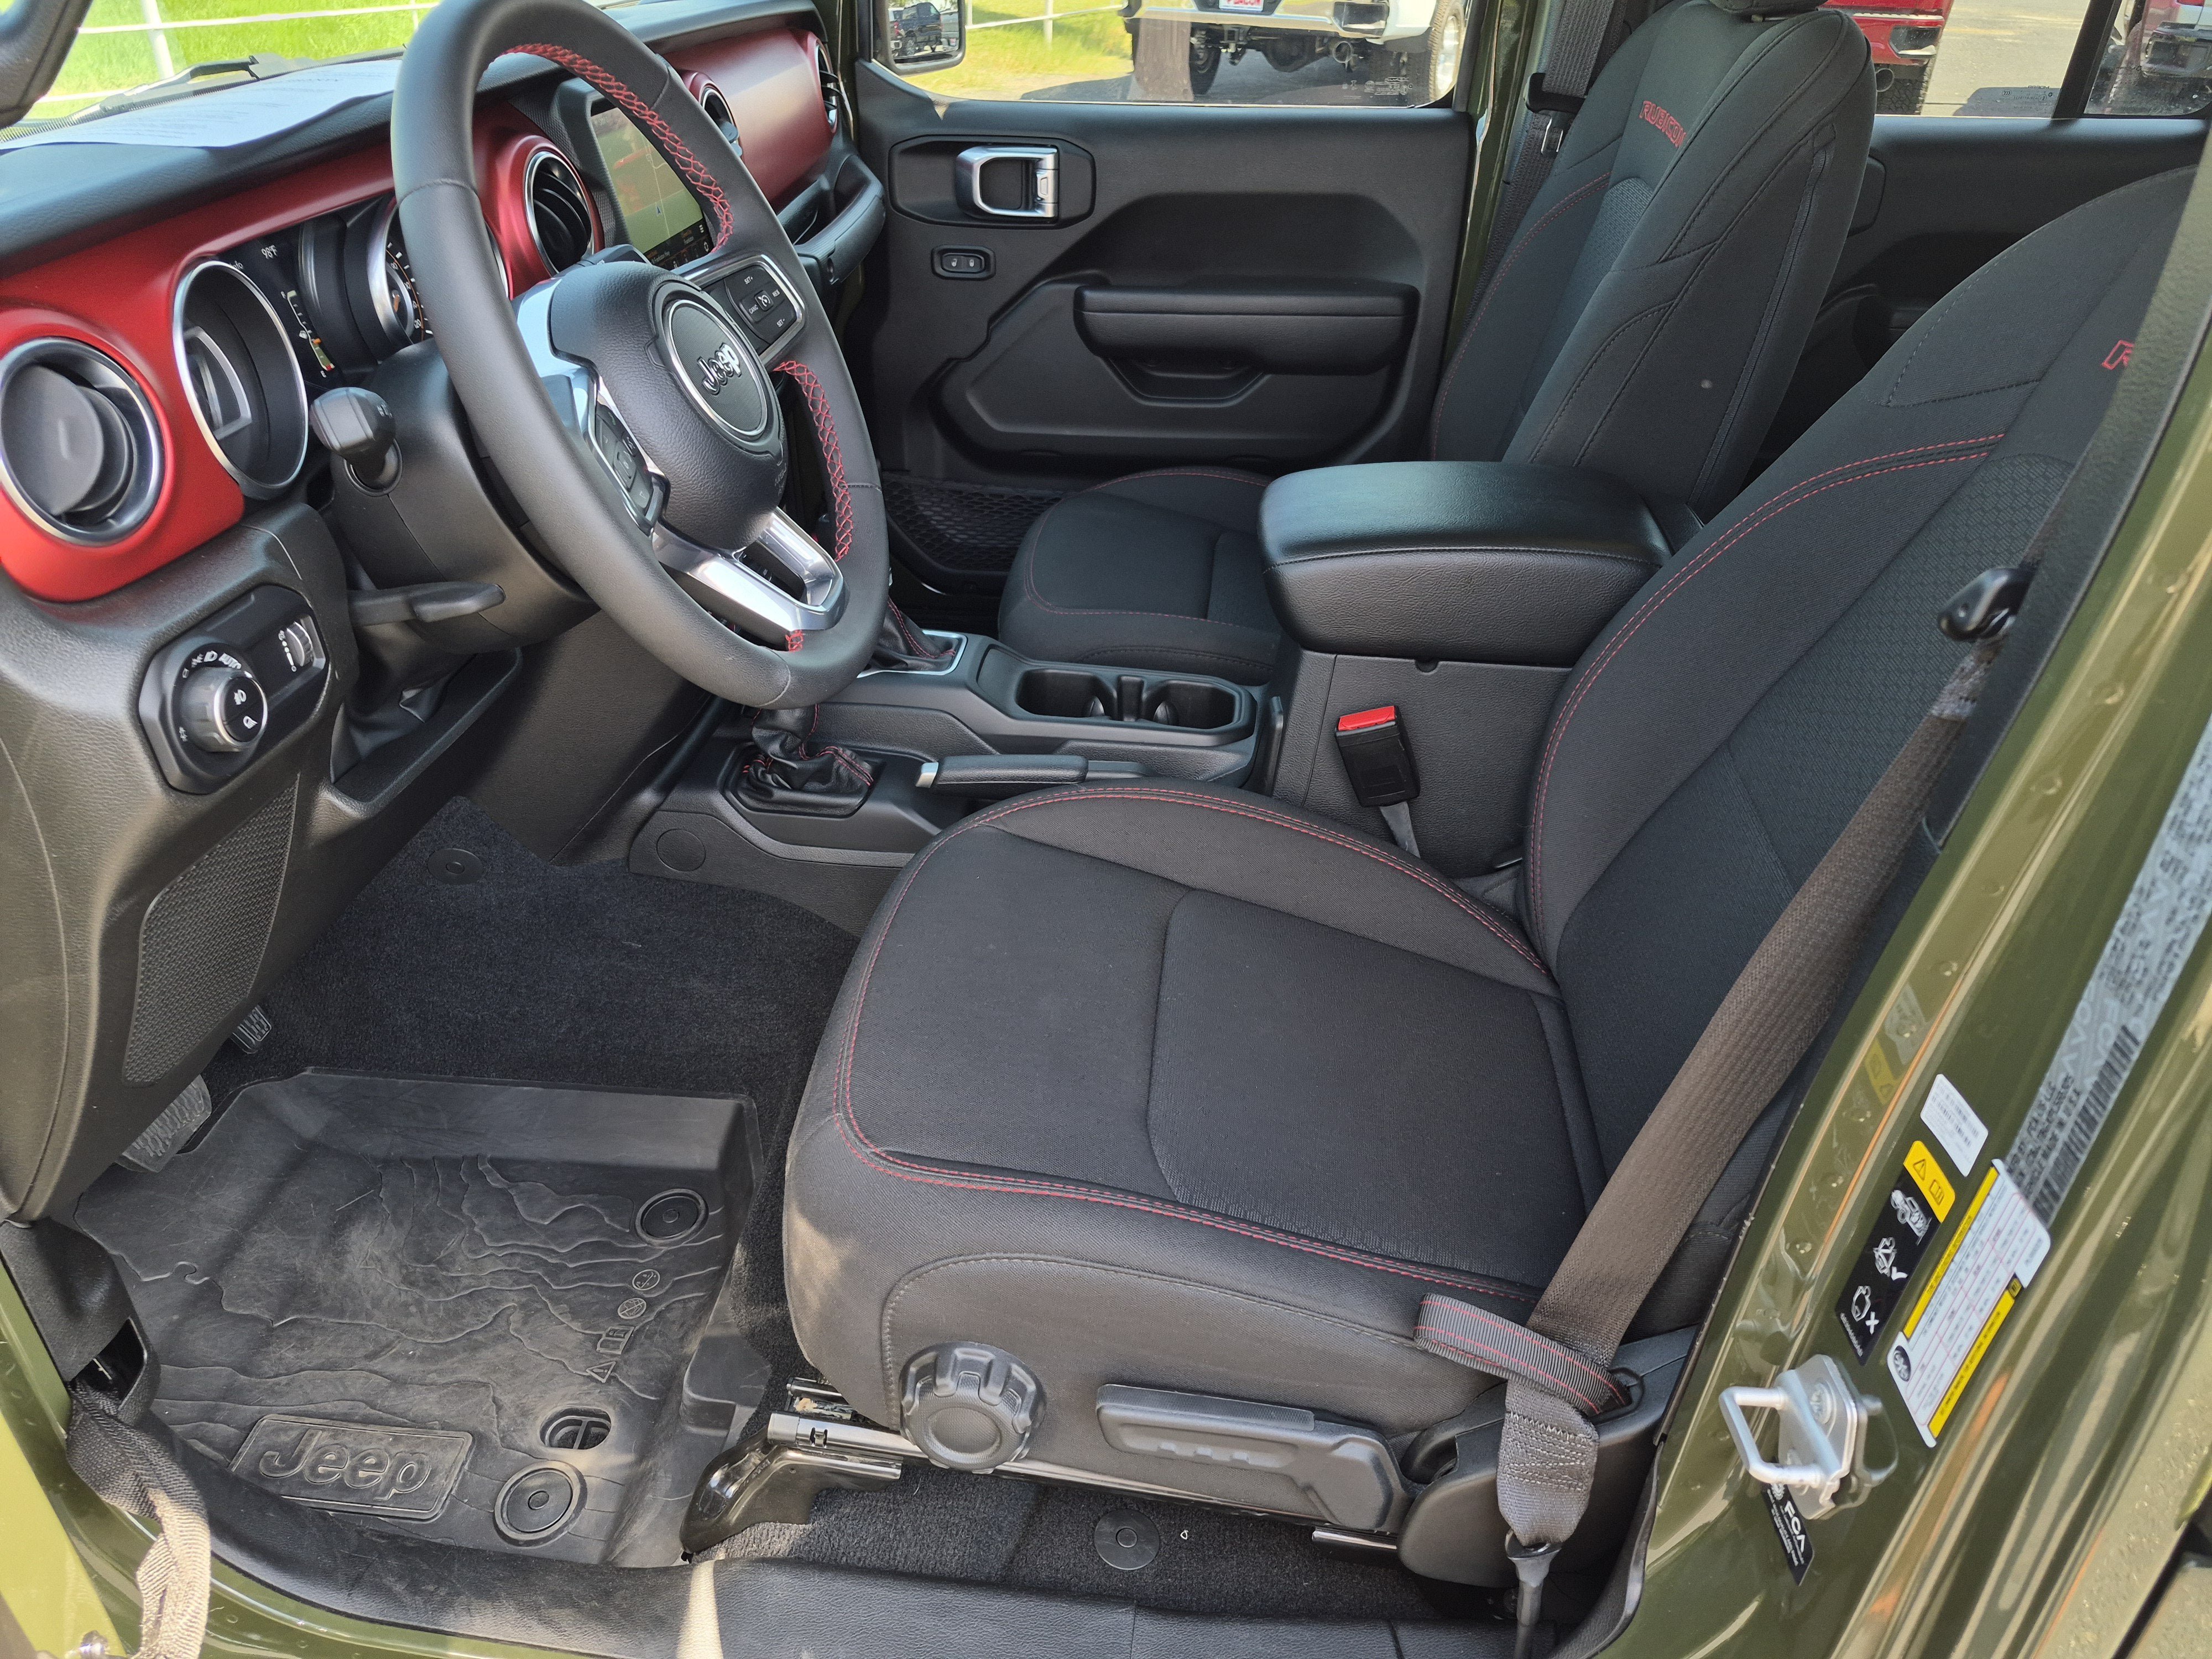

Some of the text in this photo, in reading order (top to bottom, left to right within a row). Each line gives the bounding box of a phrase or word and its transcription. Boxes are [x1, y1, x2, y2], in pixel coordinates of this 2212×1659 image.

[1639, 101, 1686, 147] RUBICON
[749, 304, 759, 314] CANC
[698, 342, 742, 395] Jeep
[218, 653, 242, 669] AUTO
[259, 1428, 431, 1501] Jeep
[1784, 1500, 1806, 1554] FCA
